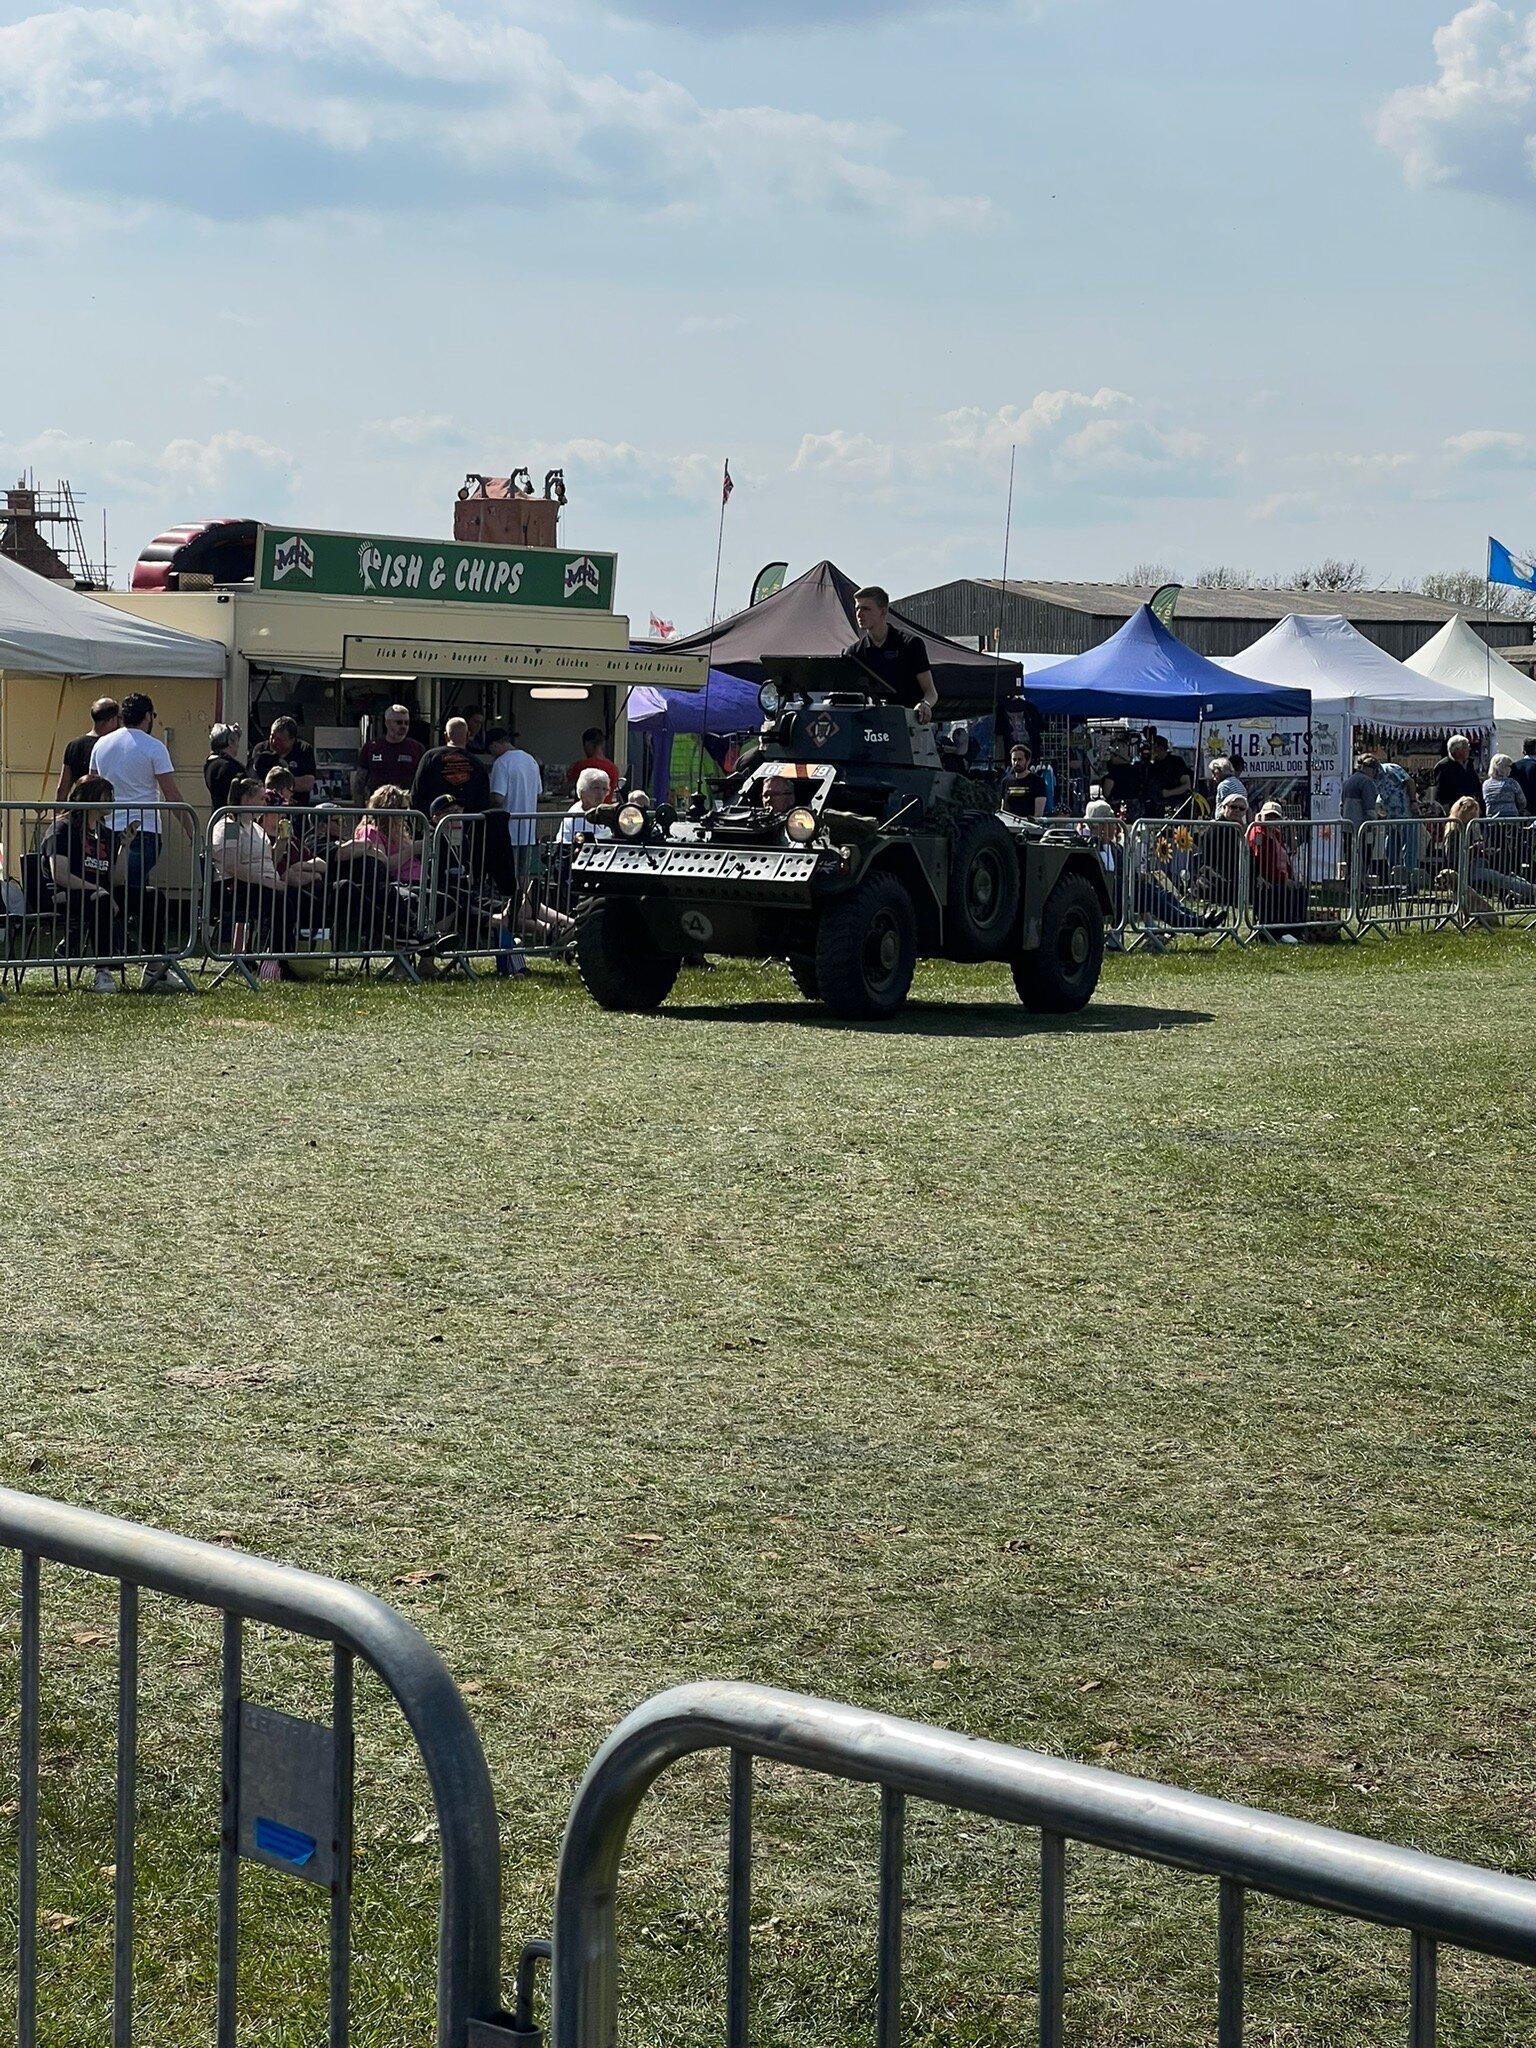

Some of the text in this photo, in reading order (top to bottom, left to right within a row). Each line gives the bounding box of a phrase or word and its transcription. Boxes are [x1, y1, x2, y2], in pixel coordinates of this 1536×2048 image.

[428, 556, 446, 590] &
[454, 558, 524, 595] CHIPS
[376, 648, 396, 658] Fish
[413, 650, 439, 662] Chips
[452, 652, 487, 664] Burgers
[504, 654, 518, 664] Hot
[523, 655, 543, 667] Dogs
[556, 658, 589, 668] Chicken
[607, 660, 620, 670] Hot
[634, 662, 652, 672] Cold
[656, 664, 683, 674] Drinks
[864, 729, 890, 742] Jase
[1250, 761, 1285, 772] NATURAL
[1287, 760, 1302, 771] DOG
